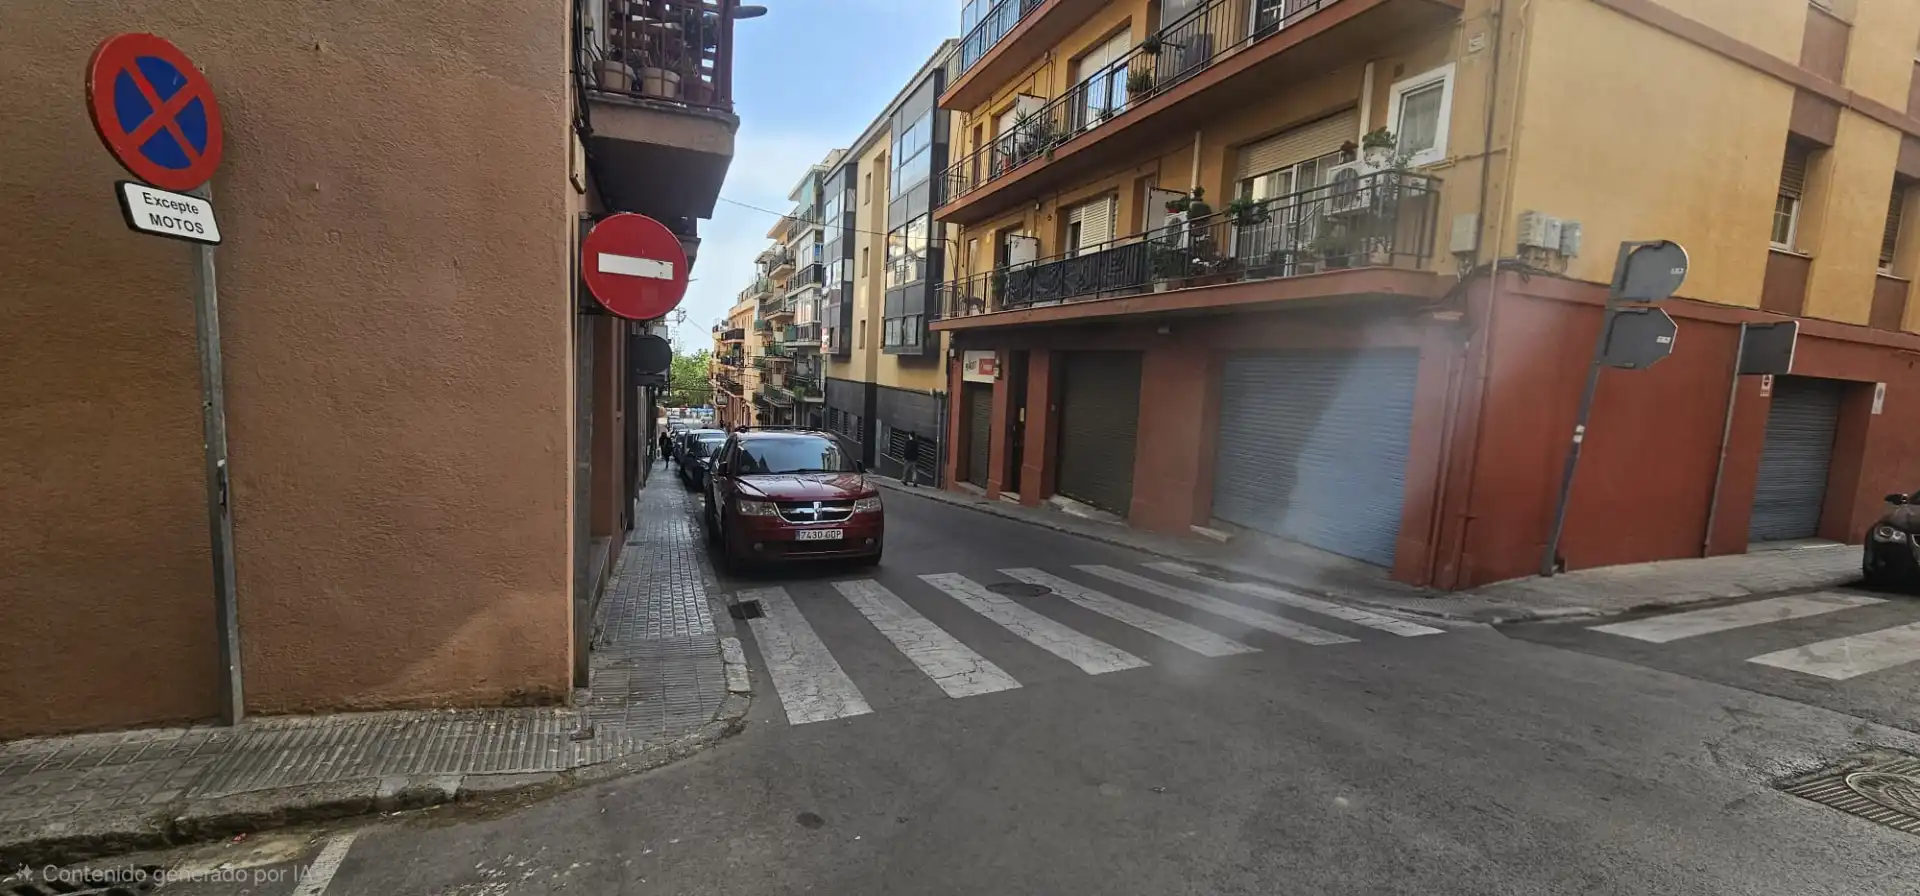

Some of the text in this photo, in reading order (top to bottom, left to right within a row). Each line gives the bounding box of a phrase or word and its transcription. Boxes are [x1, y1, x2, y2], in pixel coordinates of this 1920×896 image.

[142, 191, 199, 214] Excepte
[149, 213, 204, 234] MOTOS
[801, 531, 823, 539] 7430
